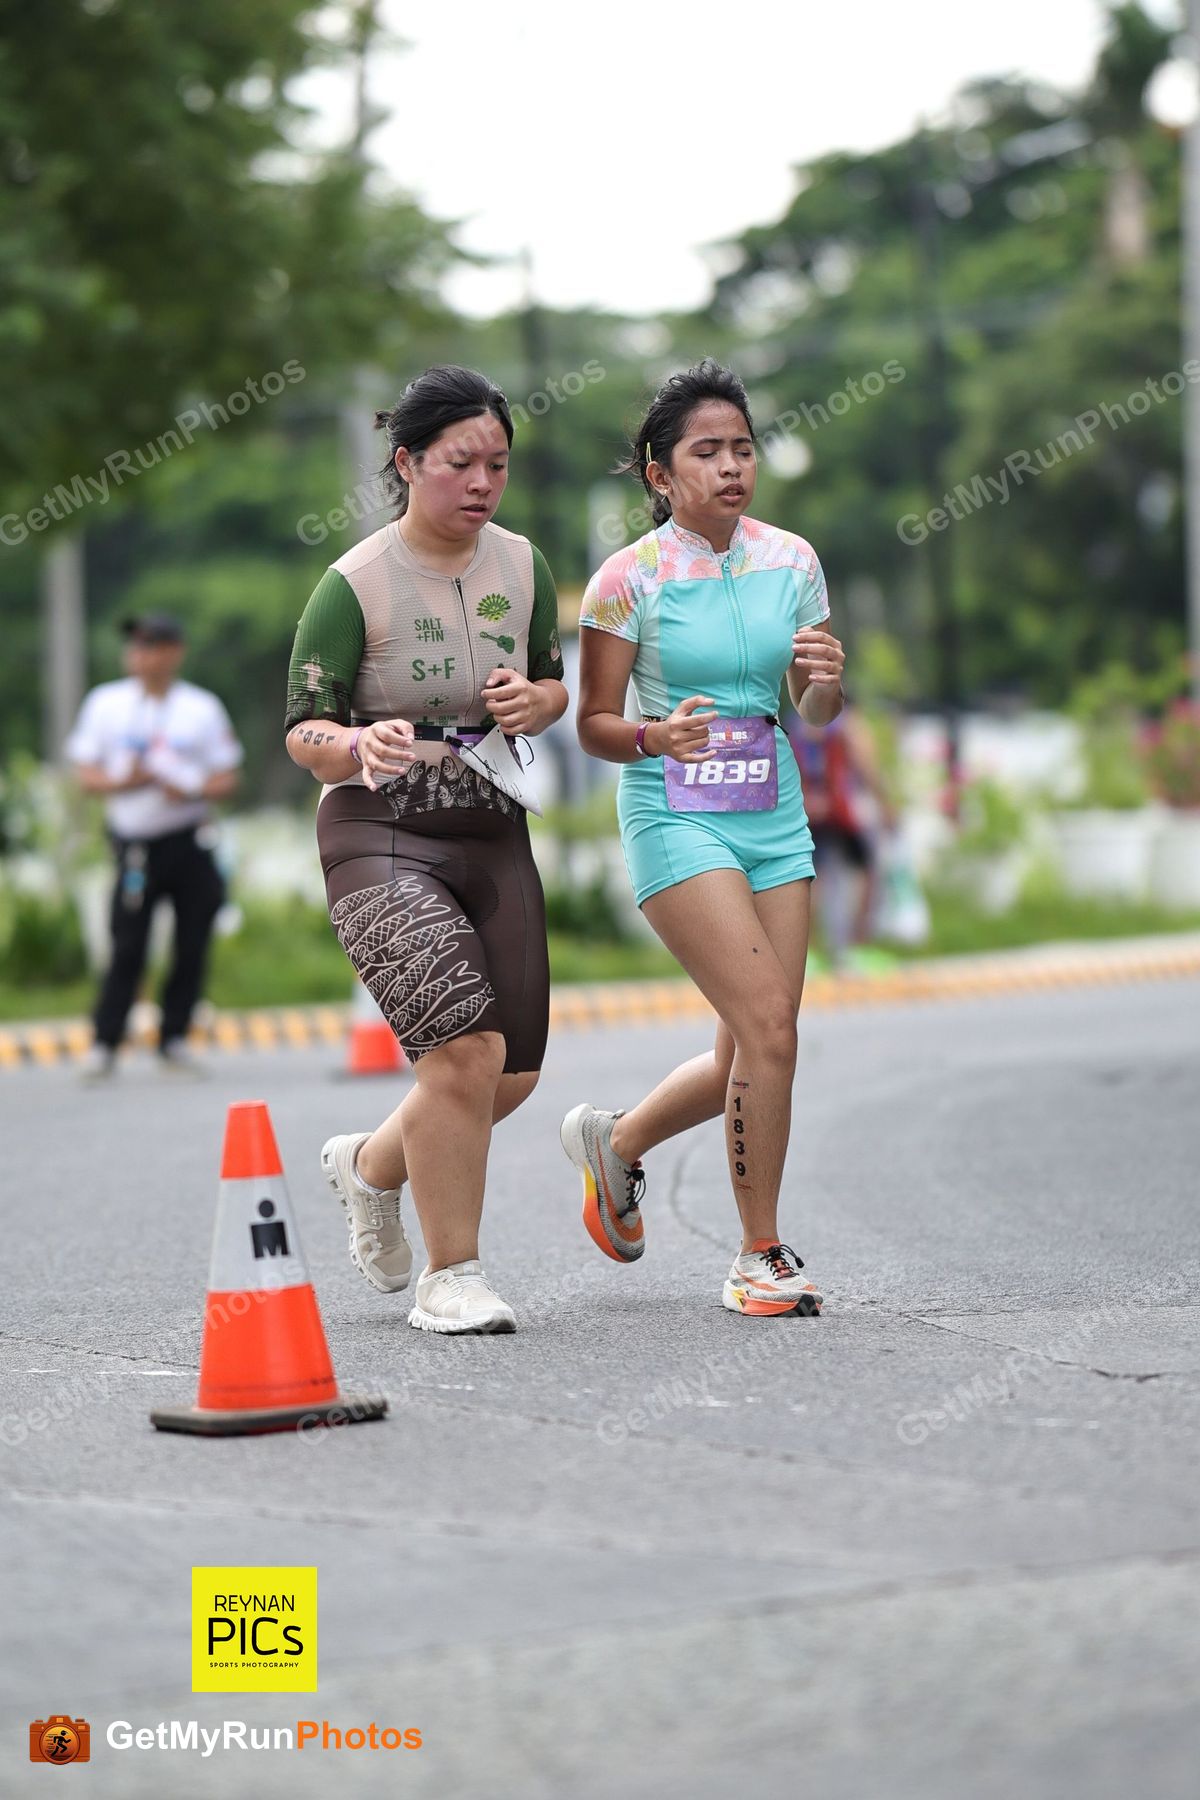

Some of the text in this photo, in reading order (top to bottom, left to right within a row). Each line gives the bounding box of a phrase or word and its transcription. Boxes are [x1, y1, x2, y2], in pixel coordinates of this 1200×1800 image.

[414, 617, 442, 632] SALT
[415, 629, 445, 643] +FIN
[411, 657, 456, 682] S+F
[683, 758, 771, 785] 1839
[733, 1096, 746, 1177] 1839
